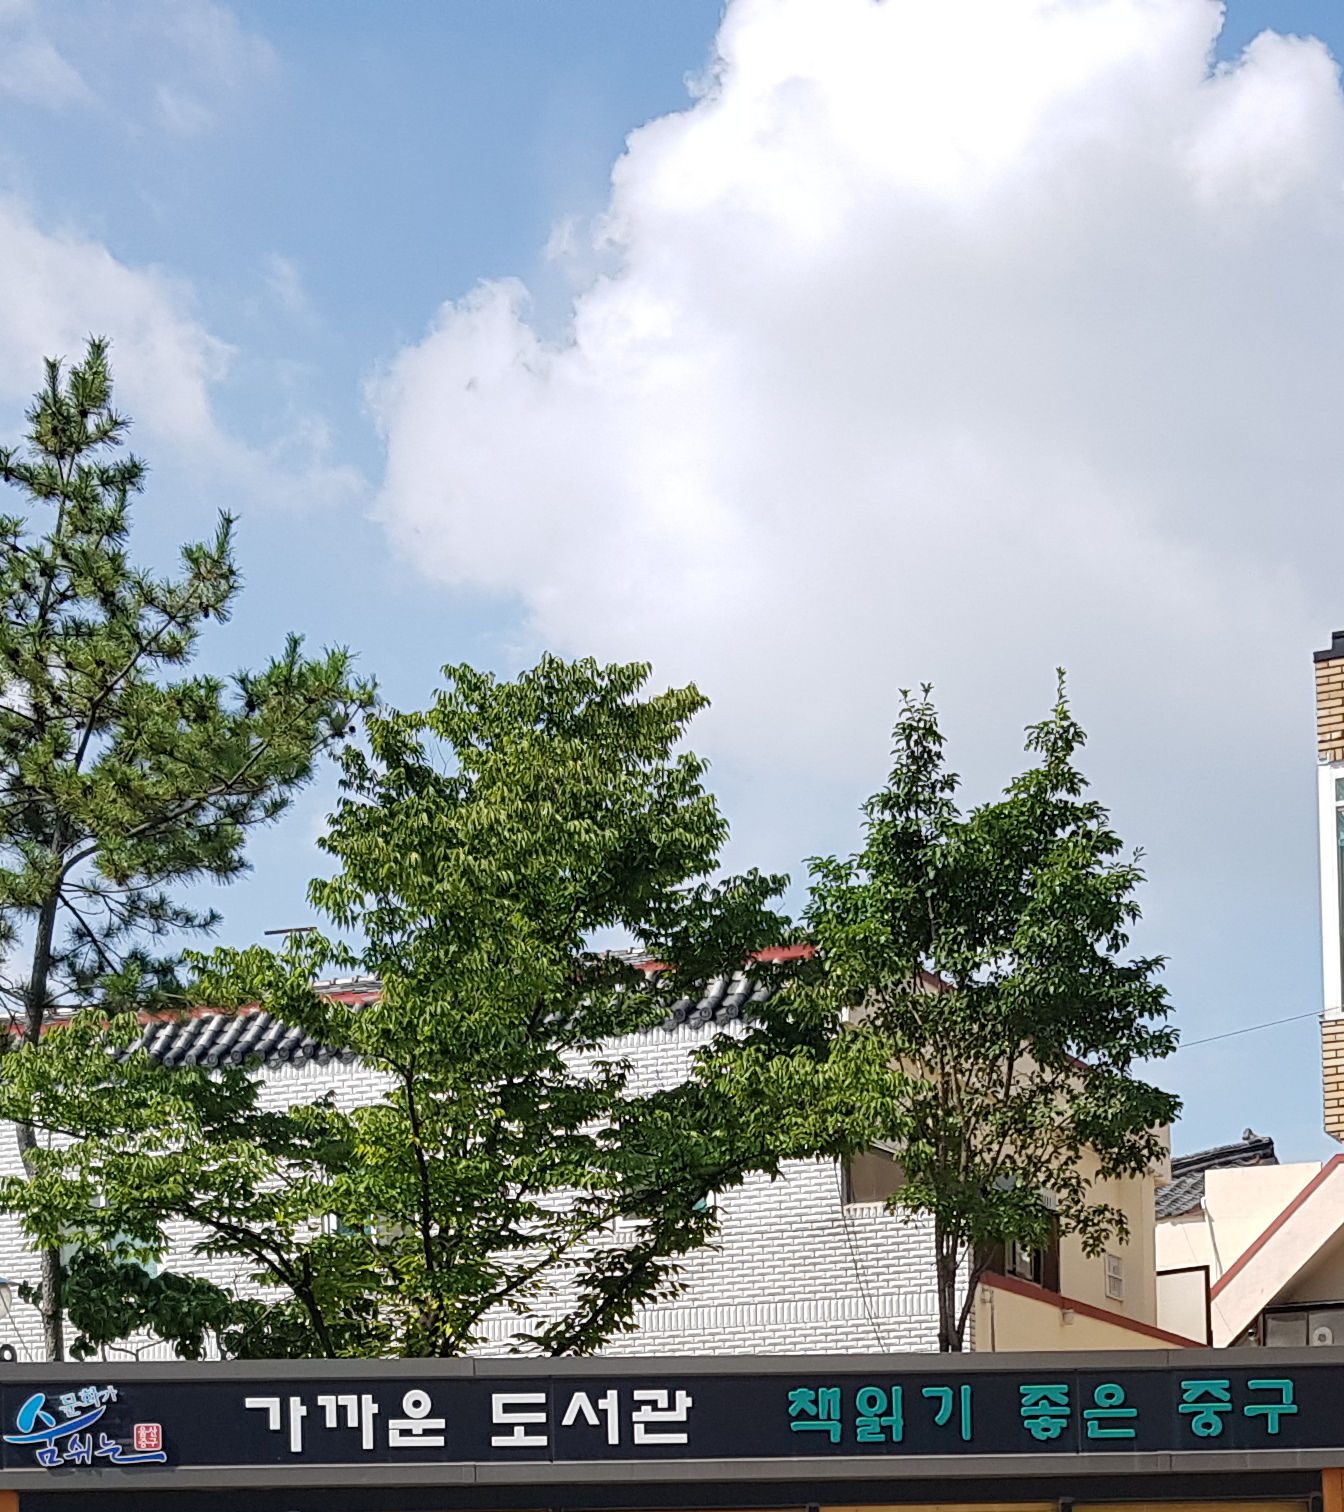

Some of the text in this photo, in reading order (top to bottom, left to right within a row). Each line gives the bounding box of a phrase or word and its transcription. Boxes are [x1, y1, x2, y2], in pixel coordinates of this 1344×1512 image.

[59, 1385, 118, 1418] 문화가
[245, 1378, 1300, 1451] 가까운 도서관 책읽기 좋은 중구
